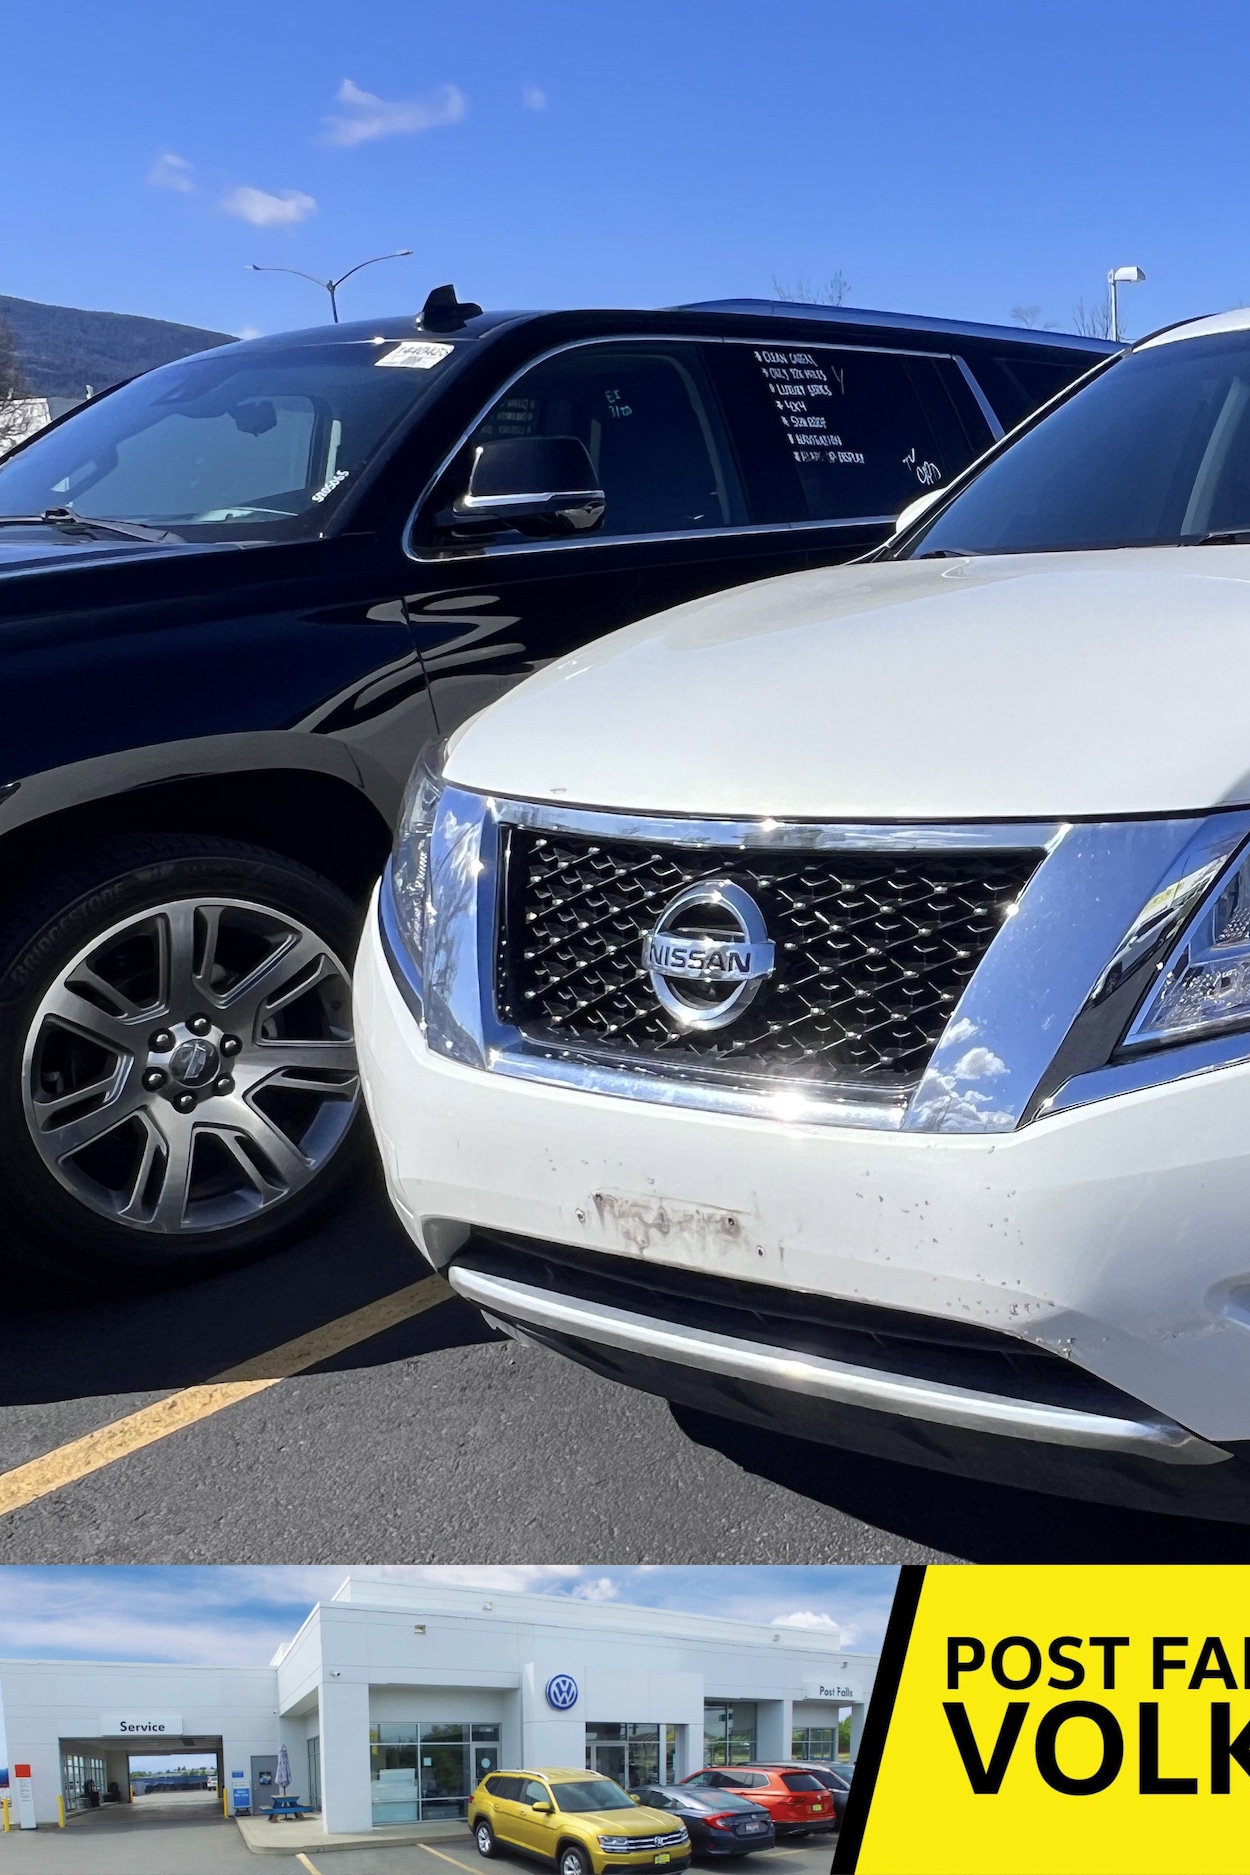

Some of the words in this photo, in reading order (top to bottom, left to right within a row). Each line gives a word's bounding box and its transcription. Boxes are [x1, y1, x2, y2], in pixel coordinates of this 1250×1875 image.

[649, 944, 752, 973] NISSAN
[819, 1686, 835, 1696] Post
[837, 1687, 853, 1697] Falls
[119, 1720, 166, 1732] Service
